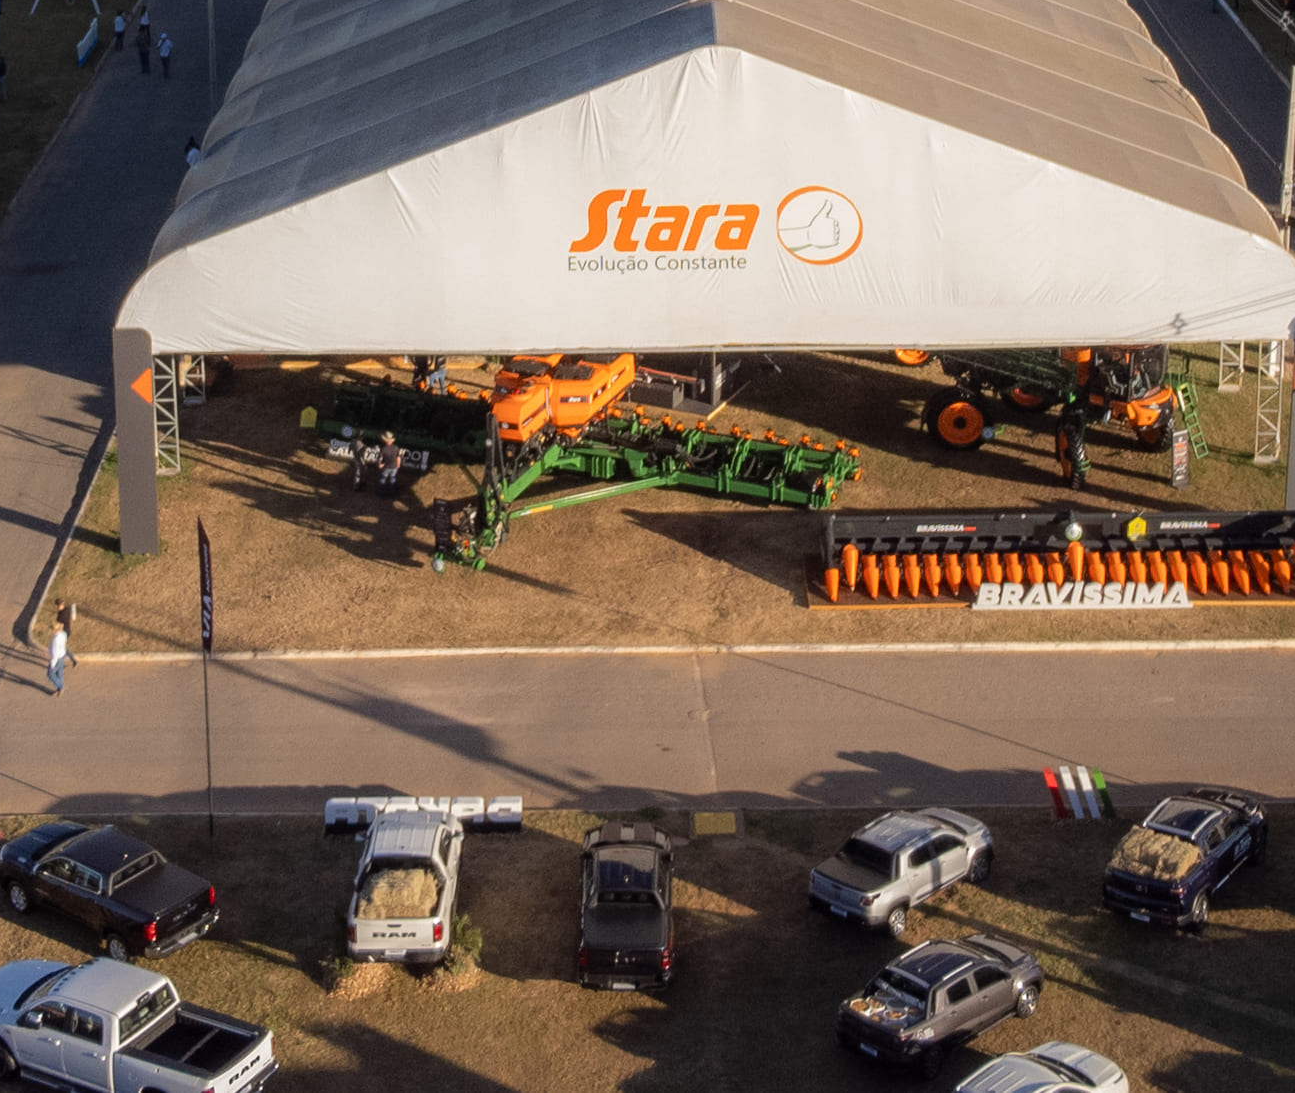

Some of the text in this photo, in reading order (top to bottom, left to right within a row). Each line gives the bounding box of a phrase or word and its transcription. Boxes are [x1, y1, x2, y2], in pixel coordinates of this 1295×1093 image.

[568, 188, 761, 253] Stara
[567, 254, 747, 275] Evolução Constante
[228, 1054, 261, 1085] RAM
